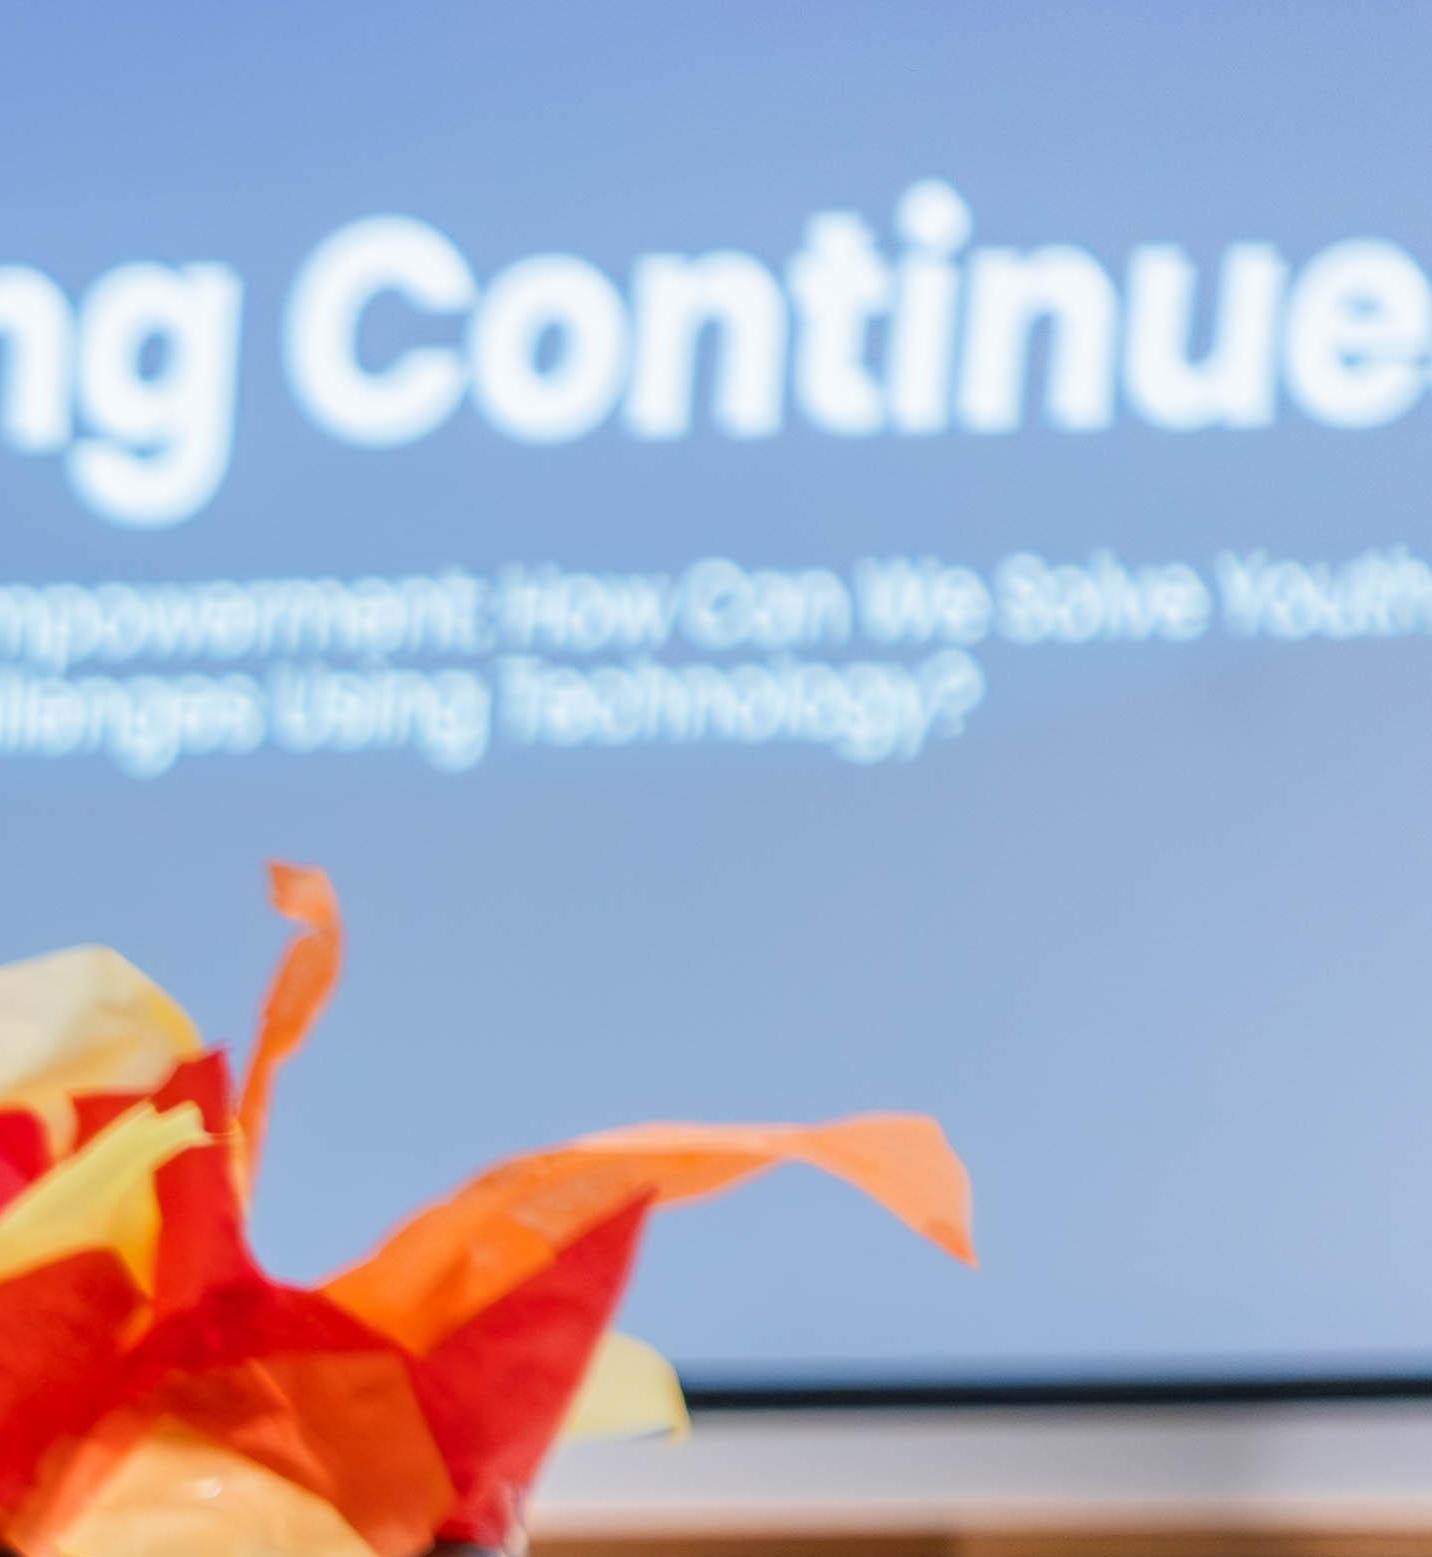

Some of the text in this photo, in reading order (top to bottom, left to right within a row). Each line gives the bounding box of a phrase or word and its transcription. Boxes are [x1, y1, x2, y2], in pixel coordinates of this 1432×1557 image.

[283, 180, 1432, 448] Continue
[498, 561, 675, 654] How
[677, 556, 852, 652] Can
[853, 553, 992, 647] We
[993, 549, 1213, 645] Solve
[270, 657, 491, 774] Using
[497, 649, 987, 764] Technology?
